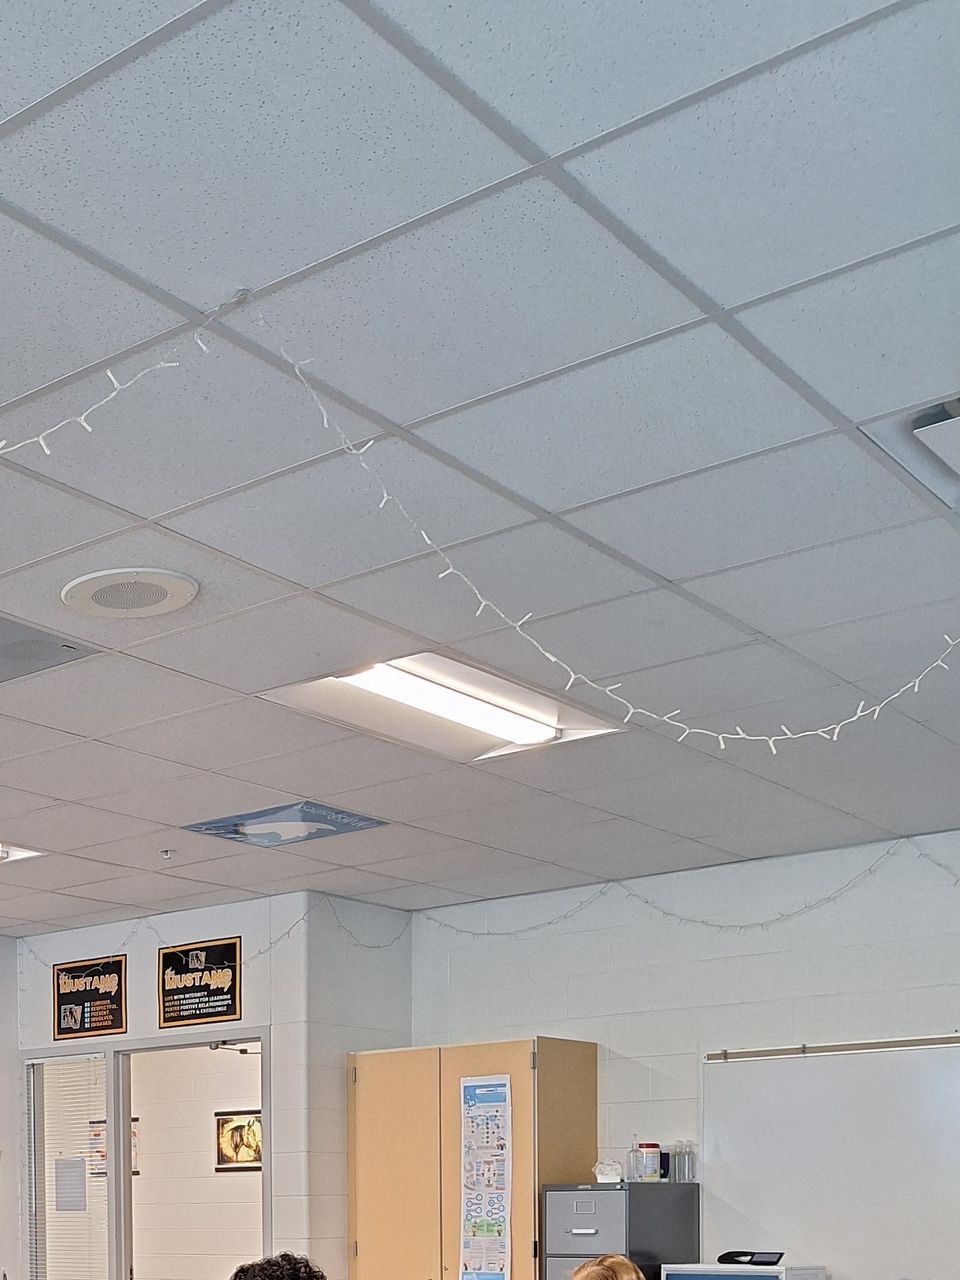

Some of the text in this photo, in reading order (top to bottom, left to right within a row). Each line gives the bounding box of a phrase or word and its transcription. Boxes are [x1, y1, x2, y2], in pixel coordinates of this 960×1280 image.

[59, 974, 119, 993] MUSTANG
[165, 969, 232, 990] MUSTANG
[198, 1000, 232, 1008] RELATIONSHIPS
